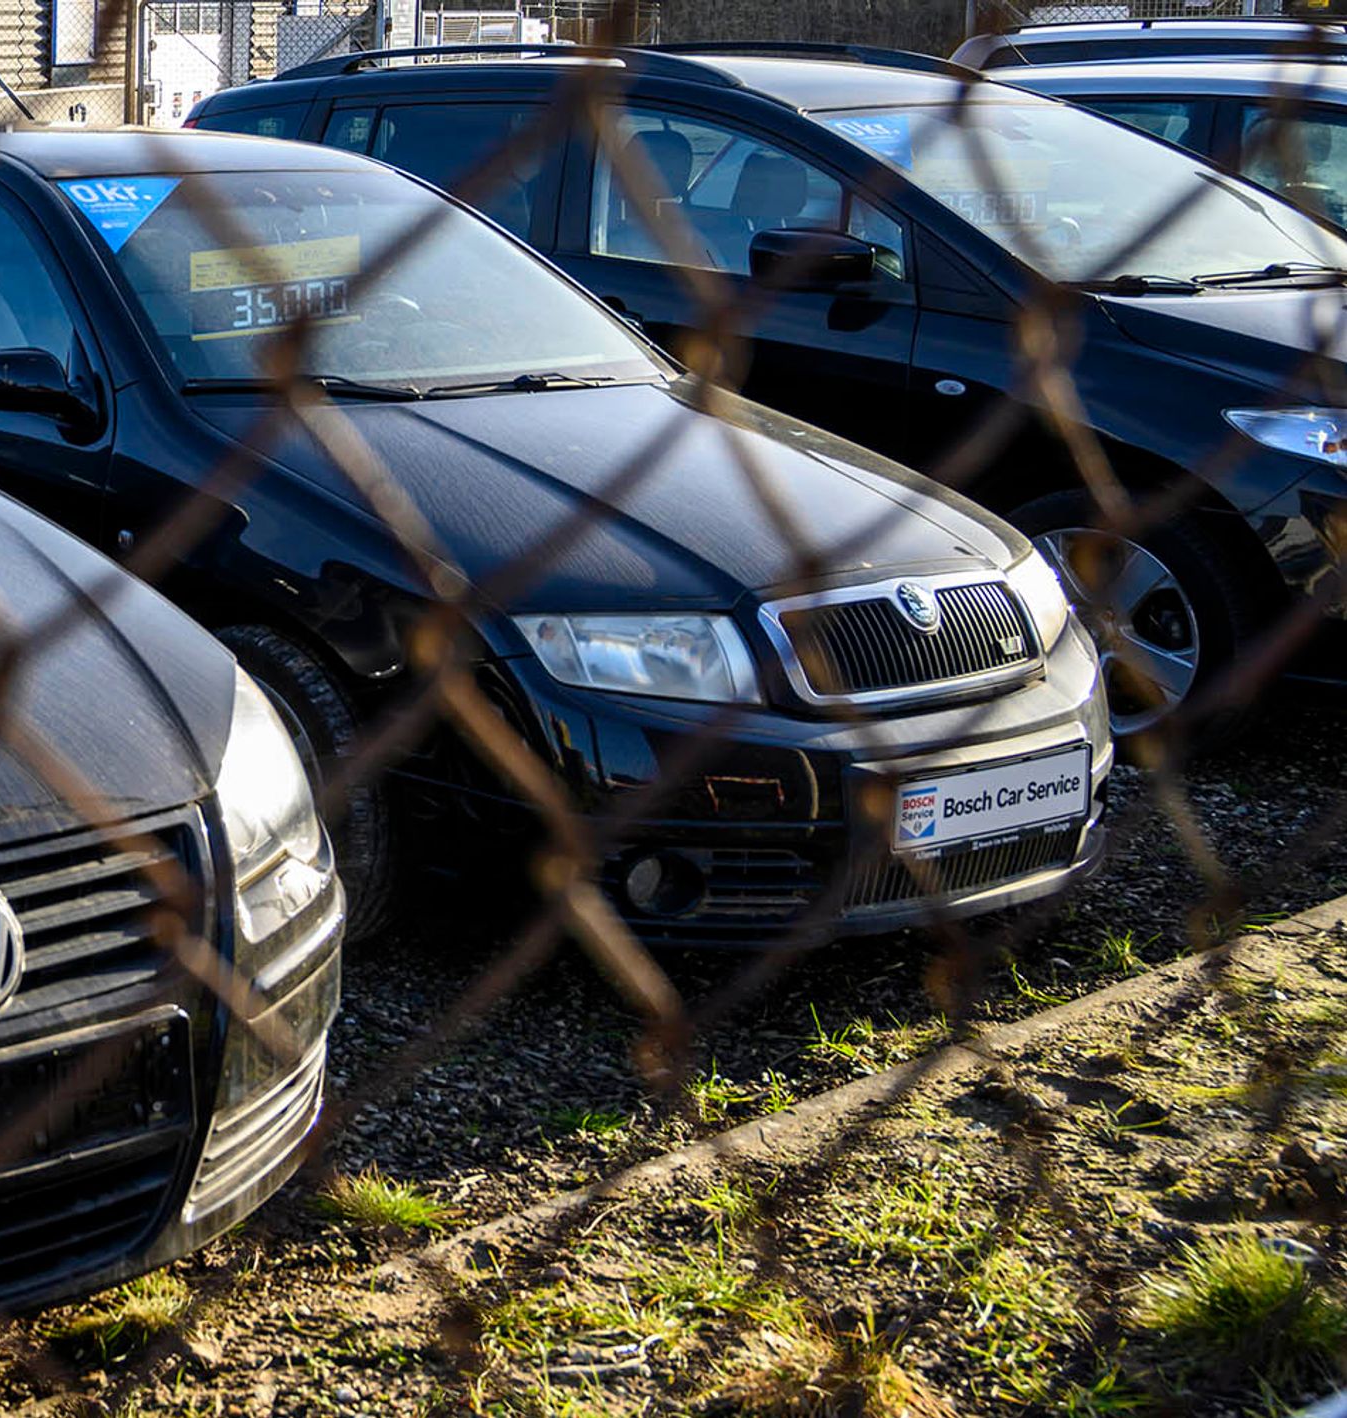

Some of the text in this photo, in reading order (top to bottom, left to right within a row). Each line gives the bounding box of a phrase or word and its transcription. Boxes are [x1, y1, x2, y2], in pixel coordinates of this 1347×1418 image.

[232, 280, 348, 328] 35.000
[903, 796, 935, 810] BOSCH
[943, 774, 1080, 818] Bosch Car Service
[902, 809, 934, 821] Service
